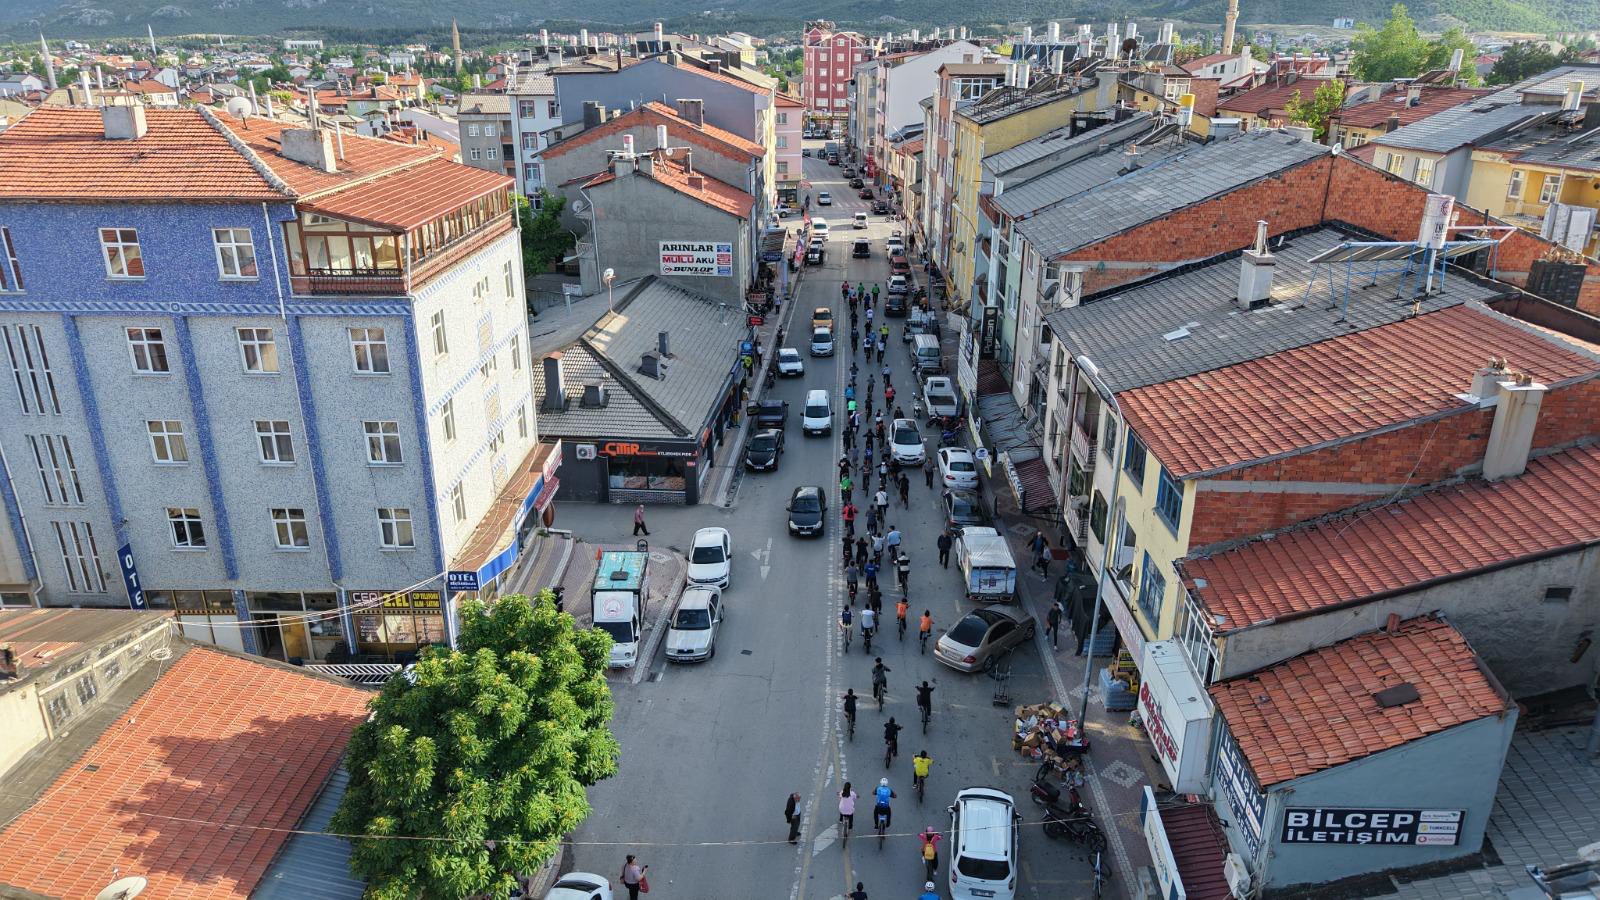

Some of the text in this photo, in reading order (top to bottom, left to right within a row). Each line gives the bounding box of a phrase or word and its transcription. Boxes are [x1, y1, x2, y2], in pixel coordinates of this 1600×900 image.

[662, 244, 714, 252] ARINLAR
[662, 255, 694, 263] MUTLU
[1287, 809, 1414, 829] BİLCEP
[1287, 829, 1410, 845] İLETİŞİM
